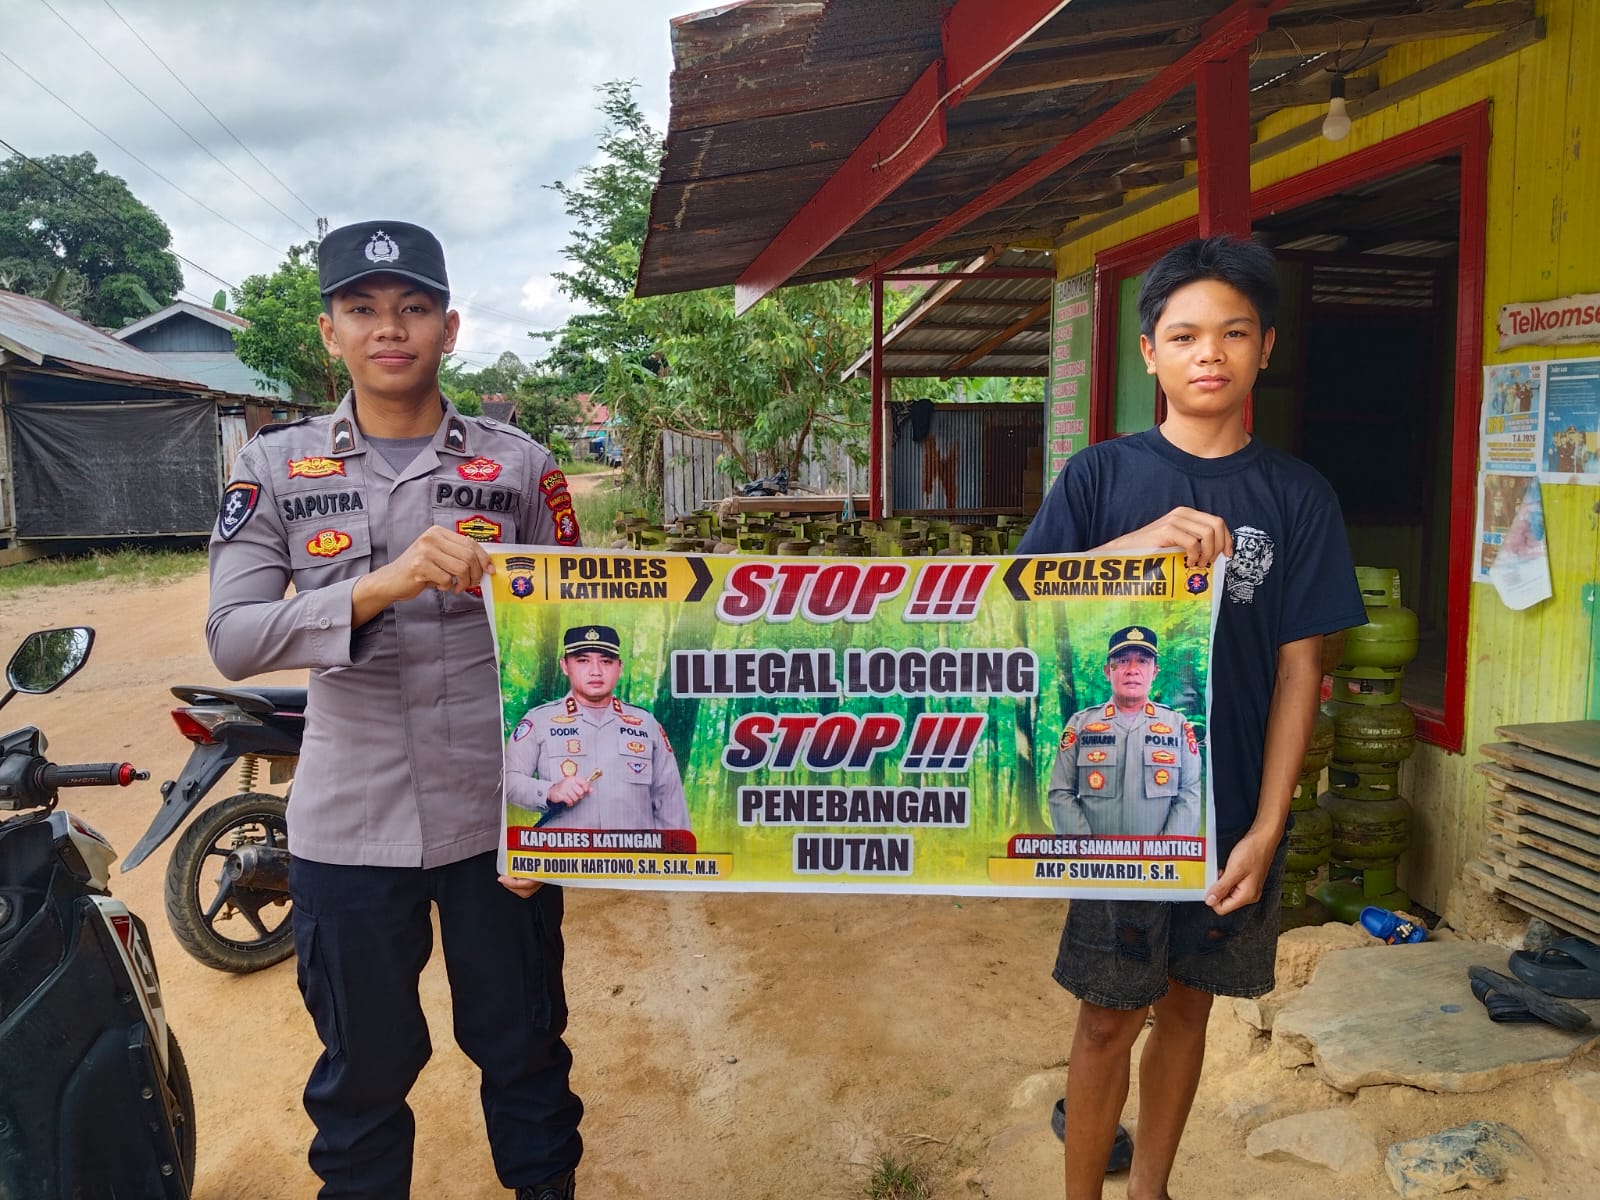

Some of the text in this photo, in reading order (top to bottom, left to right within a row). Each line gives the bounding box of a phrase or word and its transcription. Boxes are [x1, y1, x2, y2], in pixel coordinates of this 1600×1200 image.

[283, 491, 363, 522] SAPUTRA
[436, 483, 512, 511] POLRI
[559, 557, 668, 580] POLRES
[1033, 556, 1167, 581] POLSEK
[559, 581, 668, 600] KATINGAN
[720, 563, 994, 618] STOP !!!
[1033, 581, 1167, 597] SANAMAN MANTIKEI
[674, 651, 1035, 694] ILLEGAL LOGGING
[549, 727, 580, 737] DODIK
[619, 727, 649, 738] POLRI
[725, 715, 985, 769] STOP !!!
[1144, 734, 1179, 747] POLRI
[741, 789, 966, 824] PENEBANGAN
[520, 831, 662, 849] KAPOLRES KATINGAN
[1014, 838, 1203, 857] KAPOLSEK SANAMAN MANTIKEI
[796, 837, 910, 872] HUTAN
[511, 856, 541, 873] AKBP
[543, 857, 580, 874] DODIK
[581, 858, 637, 875] HARTONO,
[695, 861, 719, 876] M.H.
[1035, 862, 1179, 881] AKP SUWARDI, S.H.
